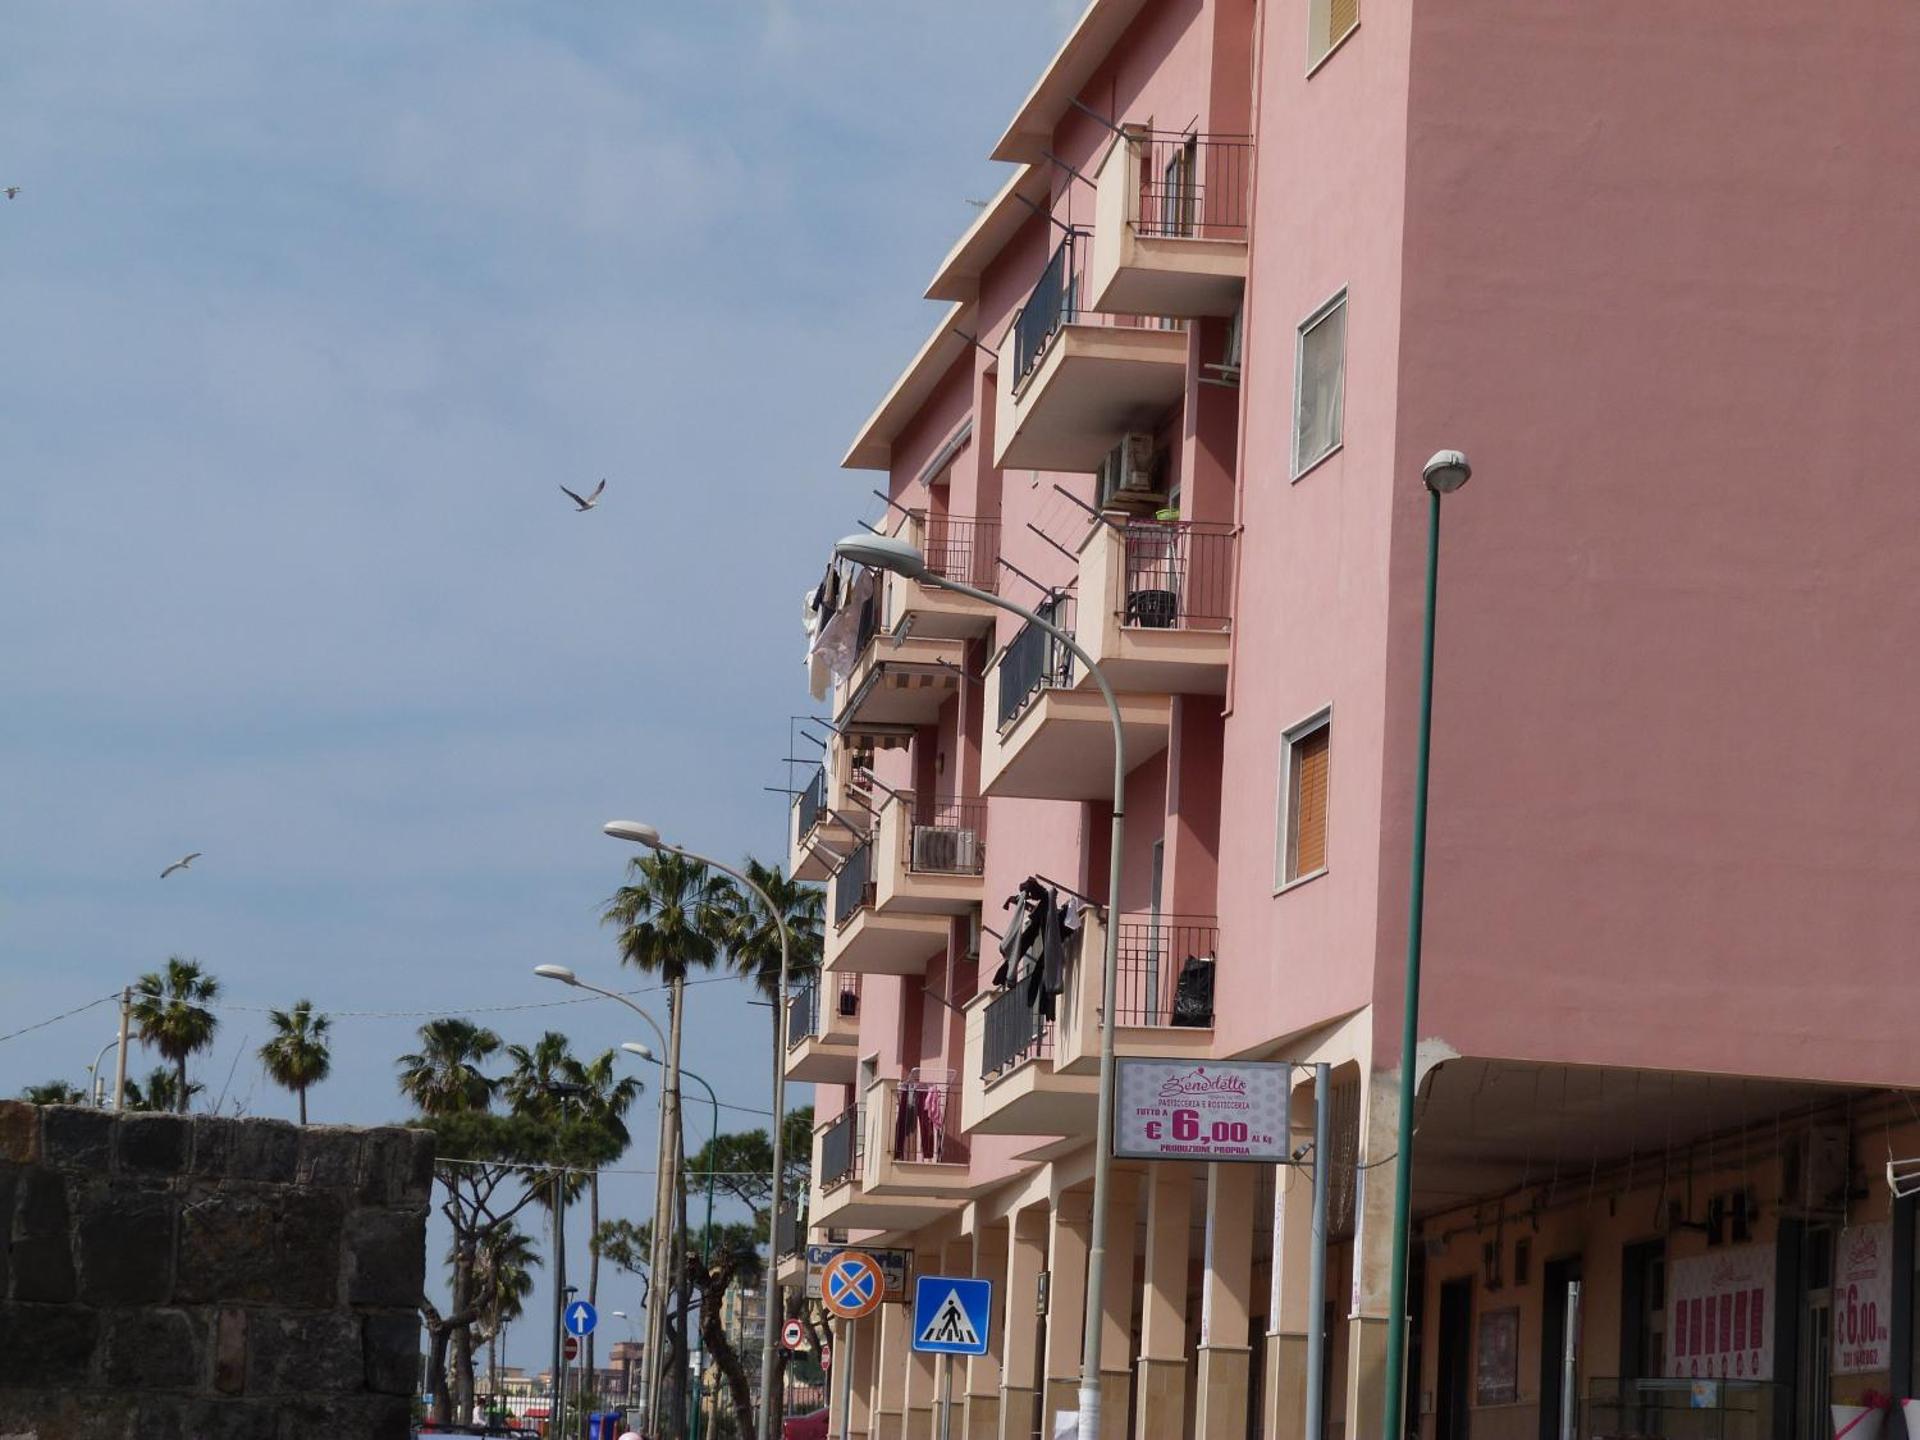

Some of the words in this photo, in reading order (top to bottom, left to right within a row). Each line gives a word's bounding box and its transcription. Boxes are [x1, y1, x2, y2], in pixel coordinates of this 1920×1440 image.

[1160, 1070, 1247, 1097] Benedetto
[1158, 1099, 1200, 1108] PASTICCERIA
[1202, 1100, 1207, 1109] E
[1207, 1100, 1250, 1110] ROSTICCERIA
[1136, 1108, 1161, 1117] TUTTO
[1162, 1109, 1168, 1117] A
[1144, 1121, 1163, 1140] €
[1172, 1109, 1248, 1145] 6,00
[1160, 1144, 1210, 1154] PRODUZIONE
[1213, 1146, 1250, 1156] PROPRIA
